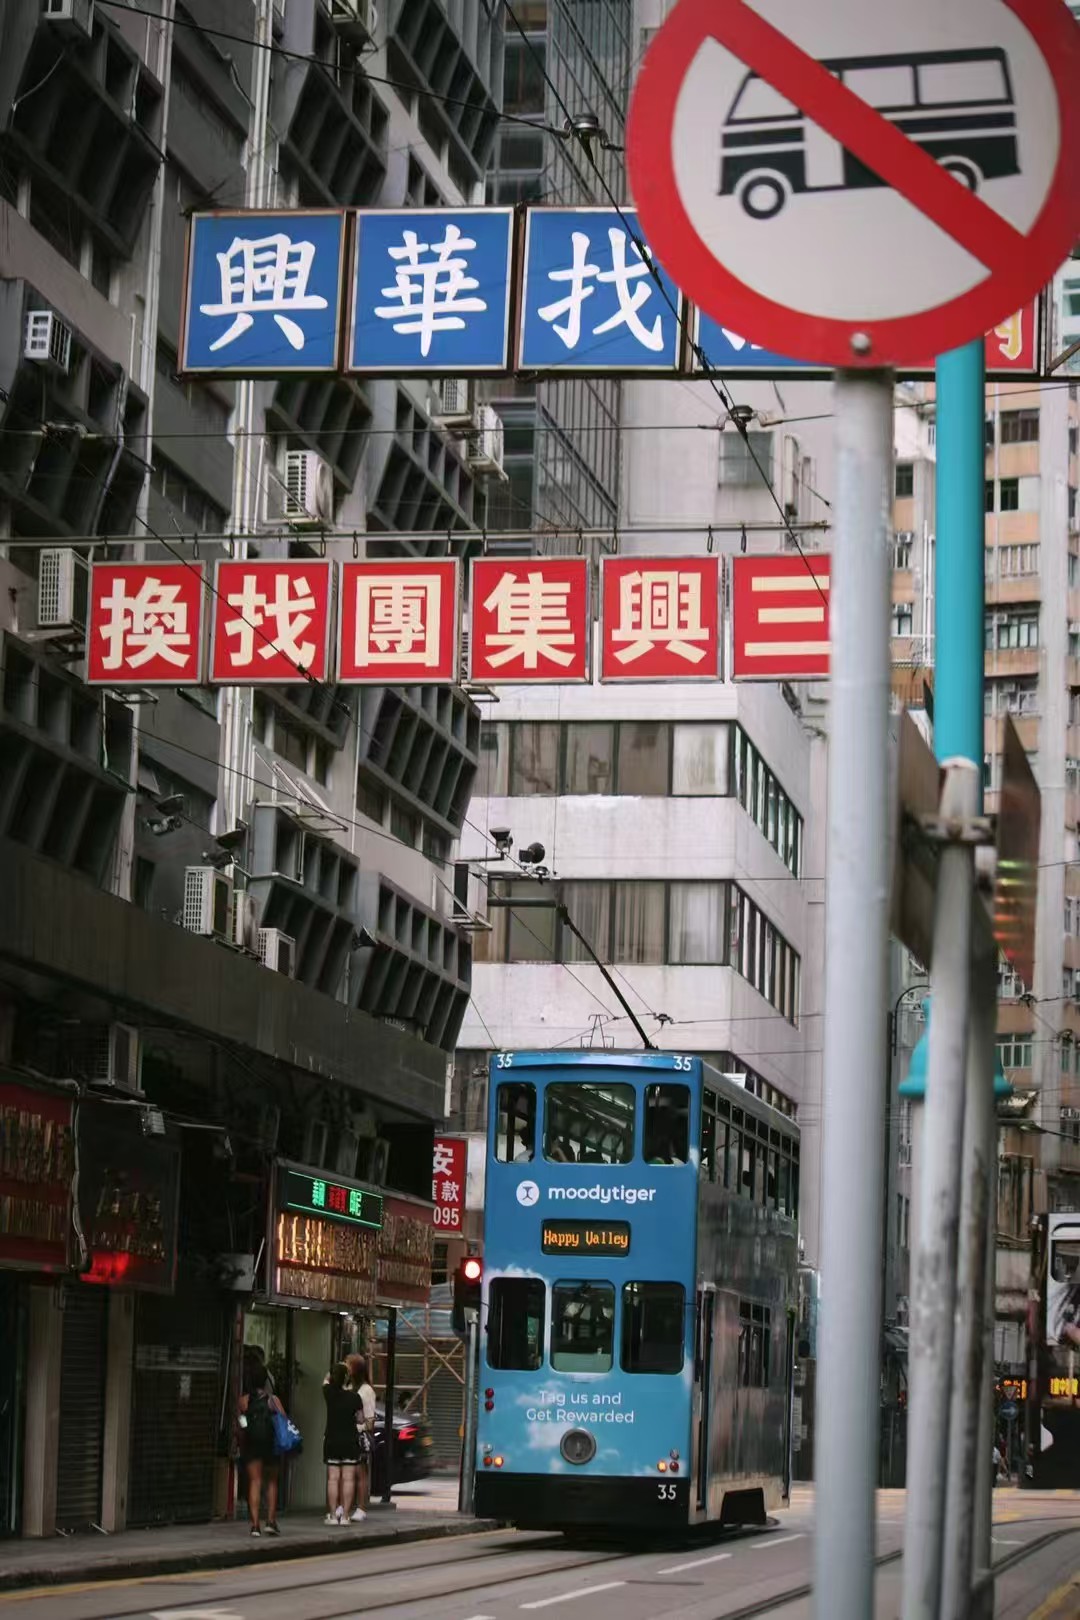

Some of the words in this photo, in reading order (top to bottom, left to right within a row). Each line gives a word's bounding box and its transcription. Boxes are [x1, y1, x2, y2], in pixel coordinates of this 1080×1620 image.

[199, 223, 763, 357] 興華找
[496, 1053, 513, 1069] 35
[673, 1055, 692, 1071] 35
[548, 1184, 657, 1204] moodytiger
[543, 1229, 580, 1248] Happy
[585, 1230, 629, 1249] Valley
[539, 1390, 566, 1406] Tag
[571, 1393, 588, 1404] us
[592, 1391, 621, 1405] and
[526, 1408, 552, 1421] Get
[556, 1409, 634, 1424] Rewarded
[657, 1484, 677, 1500] 35
